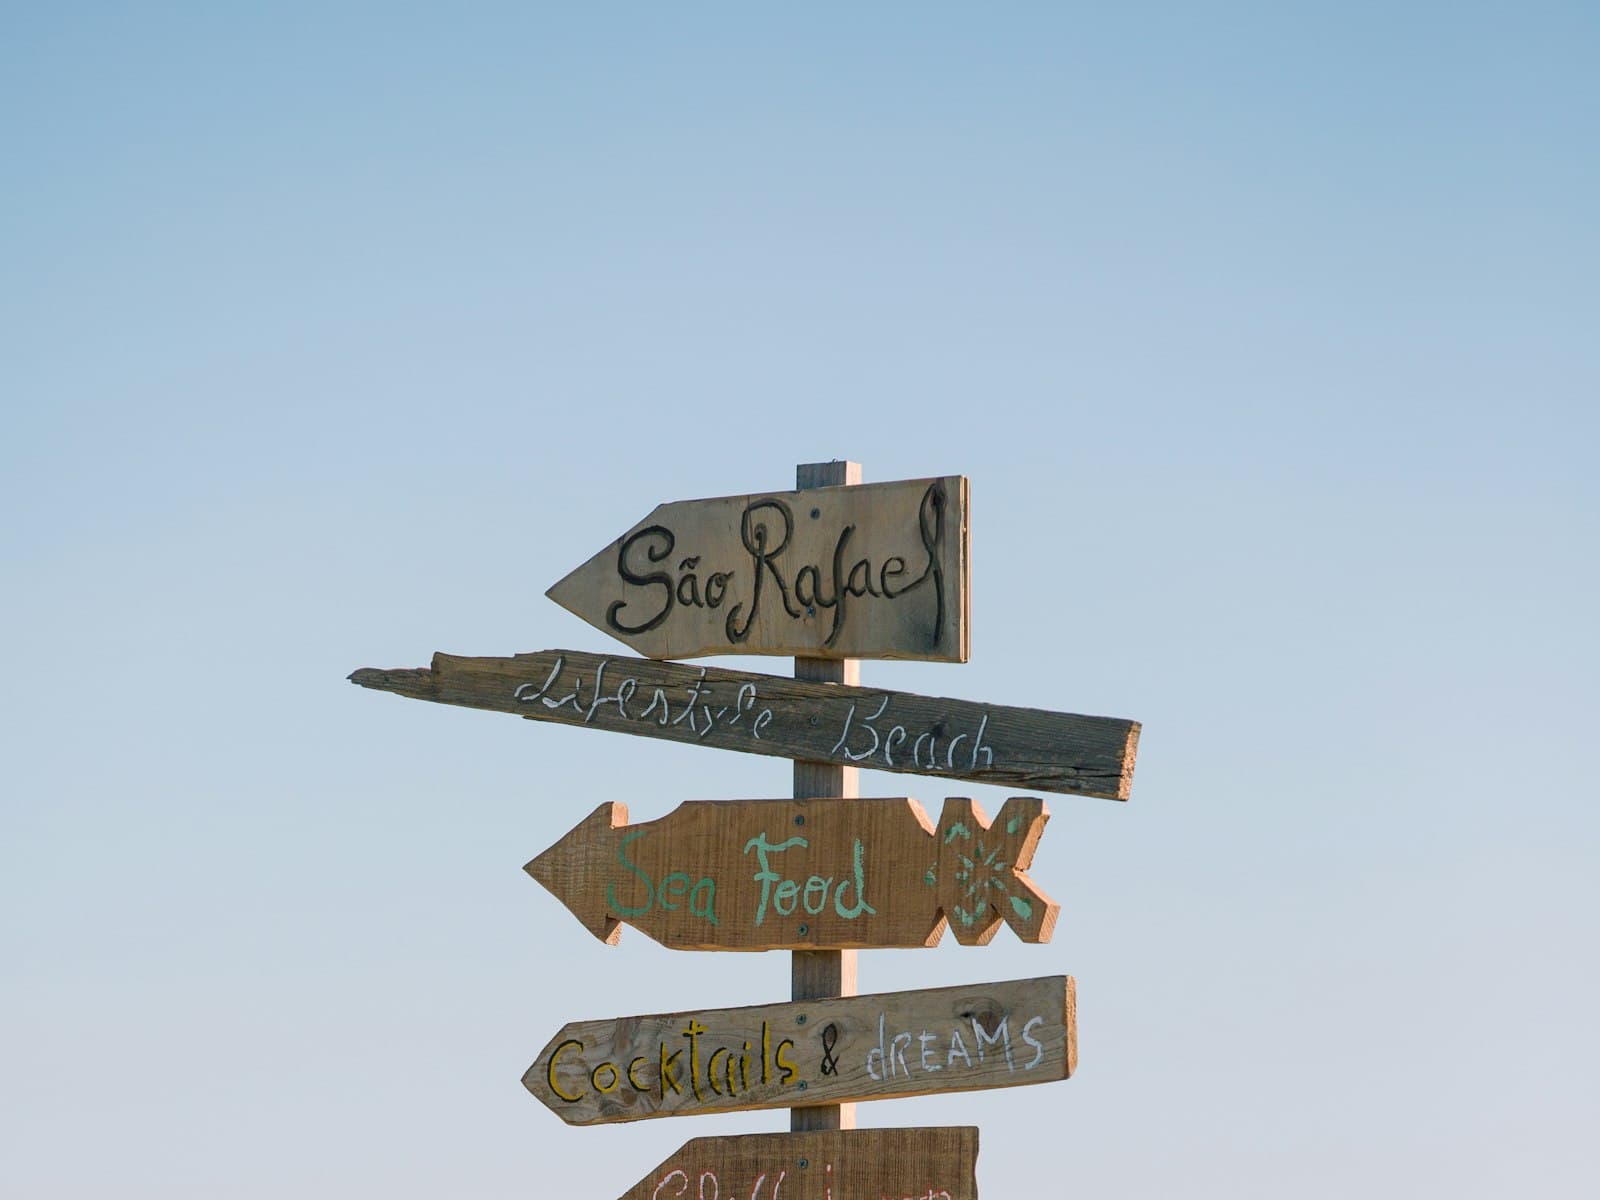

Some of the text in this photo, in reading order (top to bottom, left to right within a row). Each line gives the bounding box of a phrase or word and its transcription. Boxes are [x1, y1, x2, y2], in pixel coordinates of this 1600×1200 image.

[606, 481, 946, 649] São Rafael
[513, 655, 994, 770] Lifestyle Beach
[607, 830, 877, 926] Sea Food
[546, 1011, 1046, 1103] Cocktails & dREAMS
